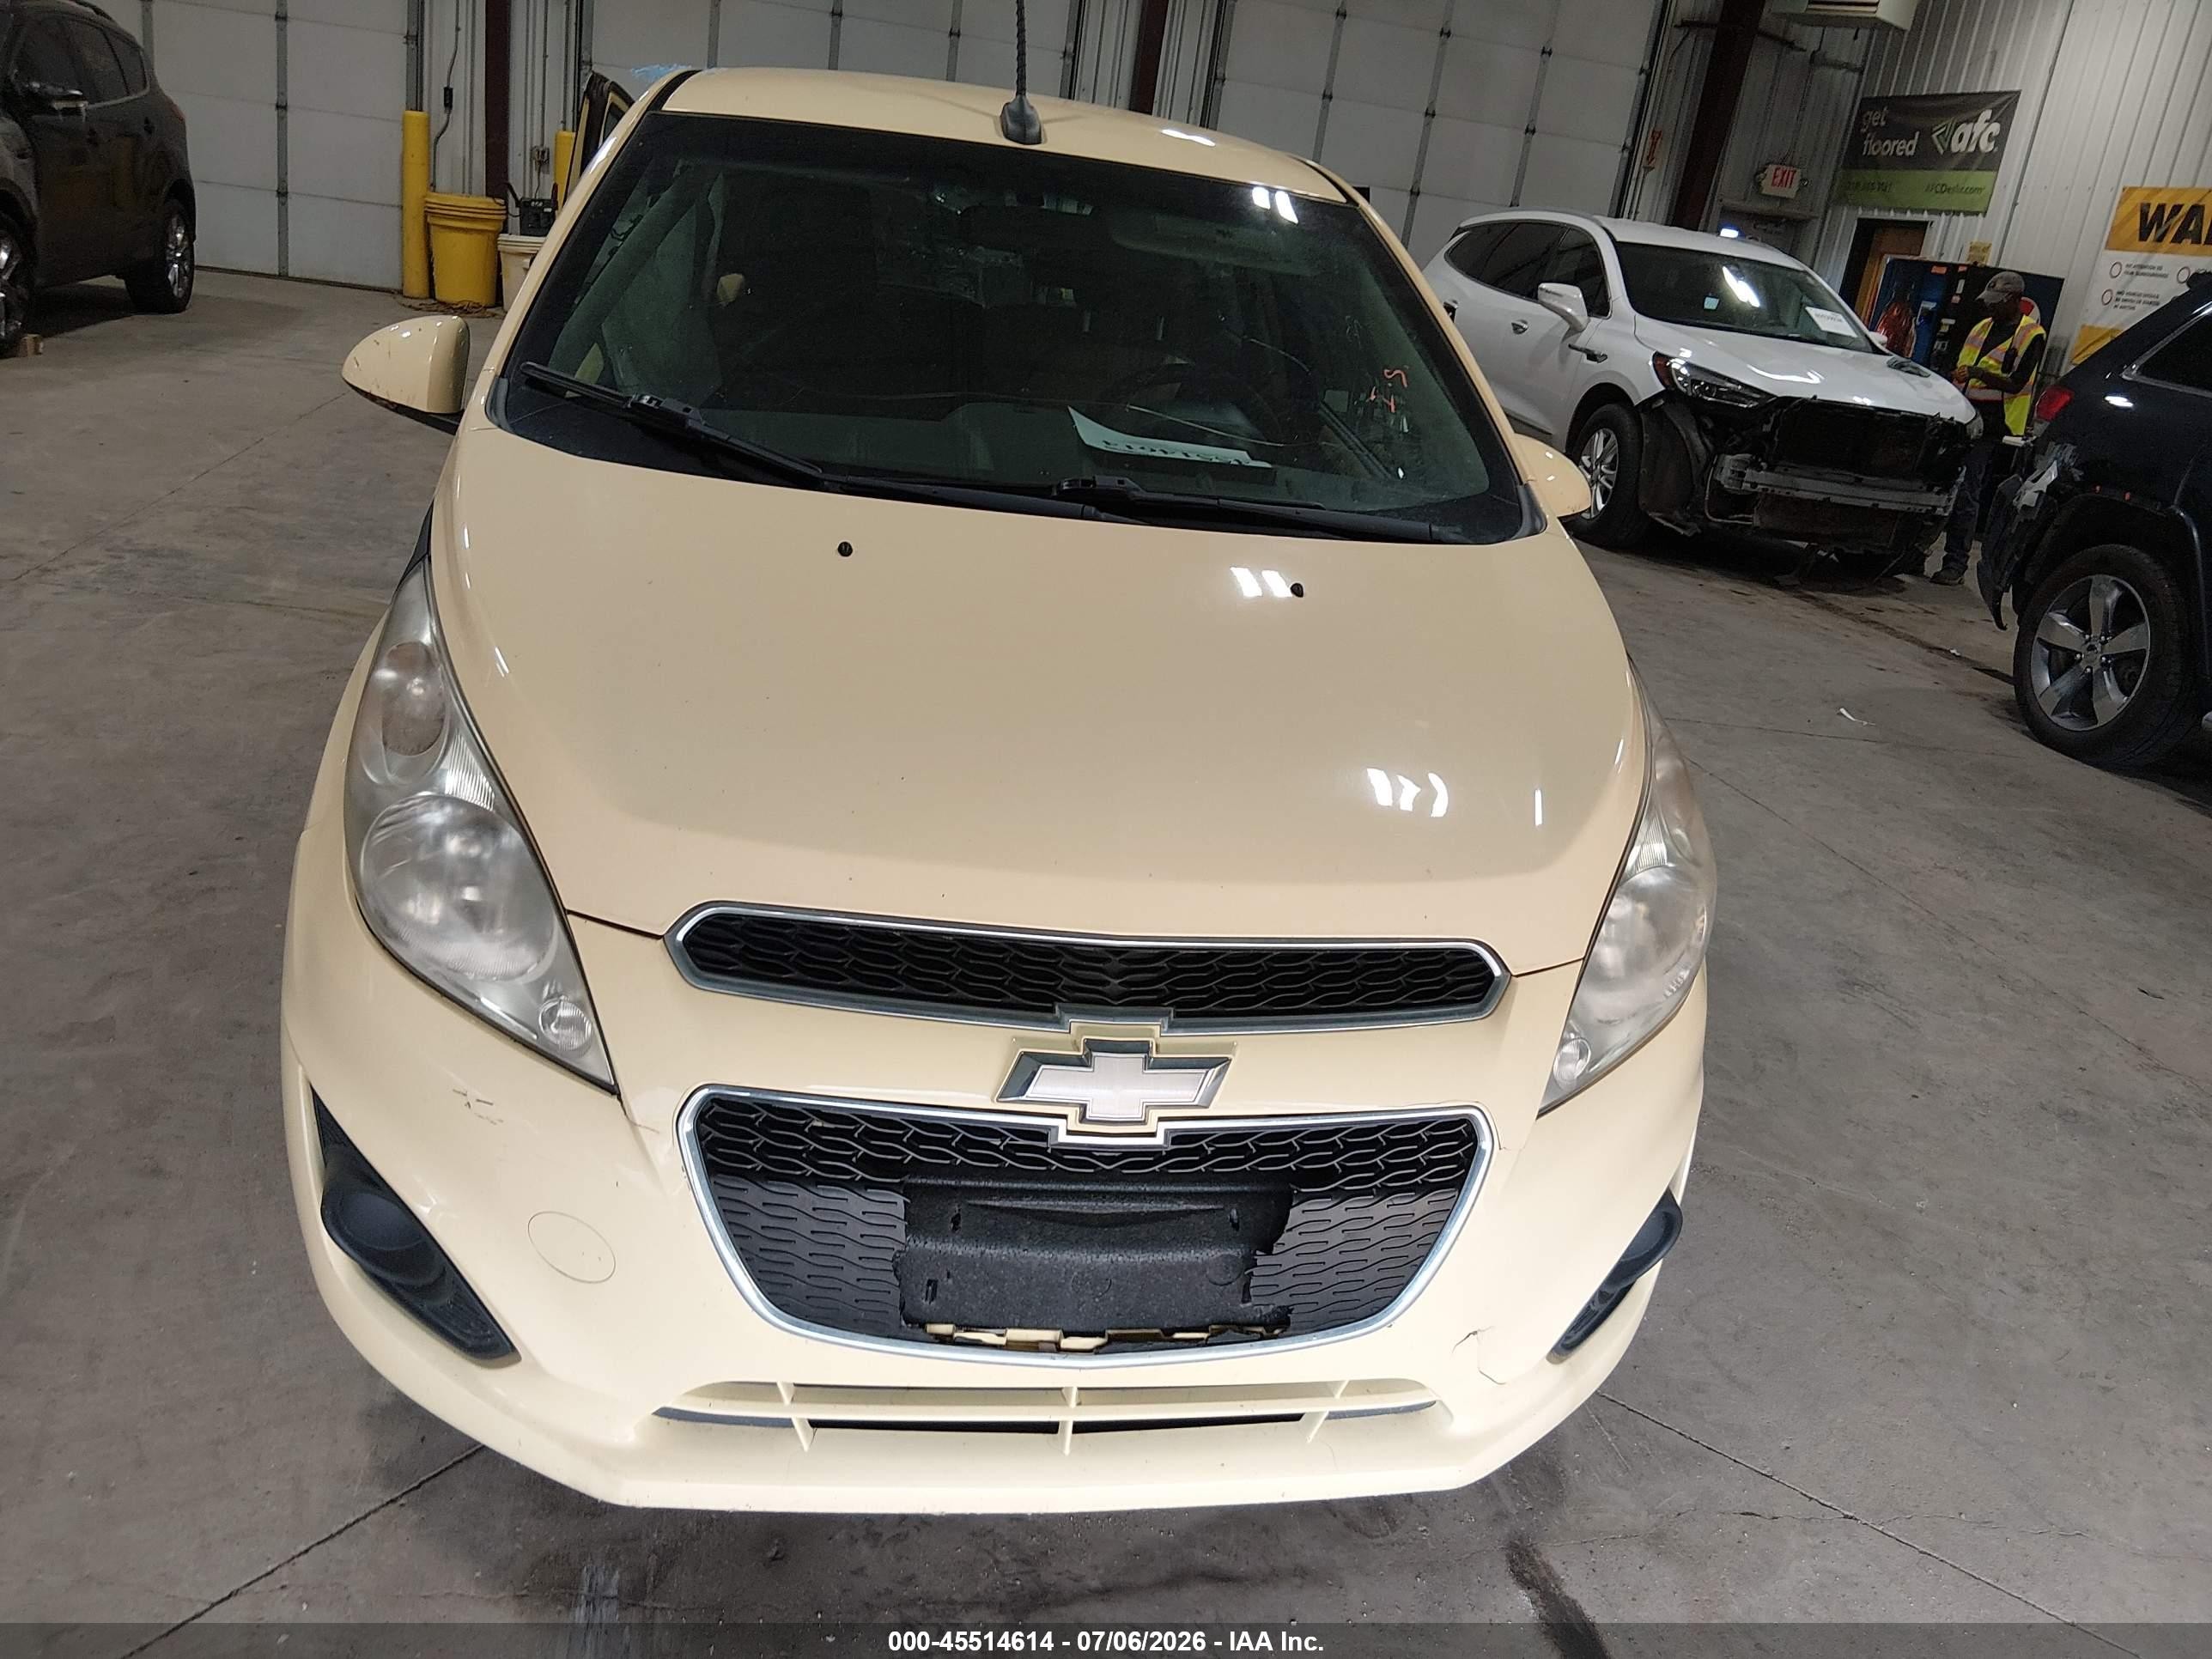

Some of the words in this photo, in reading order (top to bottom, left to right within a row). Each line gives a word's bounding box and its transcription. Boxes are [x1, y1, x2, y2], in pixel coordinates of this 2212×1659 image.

[1860, 106, 1888, 133] get
[1950, 109, 2001, 154] afc
[1863, 131, 1920, 156] floored
[1771, 167, 1797, 189] EXIT
[2138, 203, 2212, 246] WA
